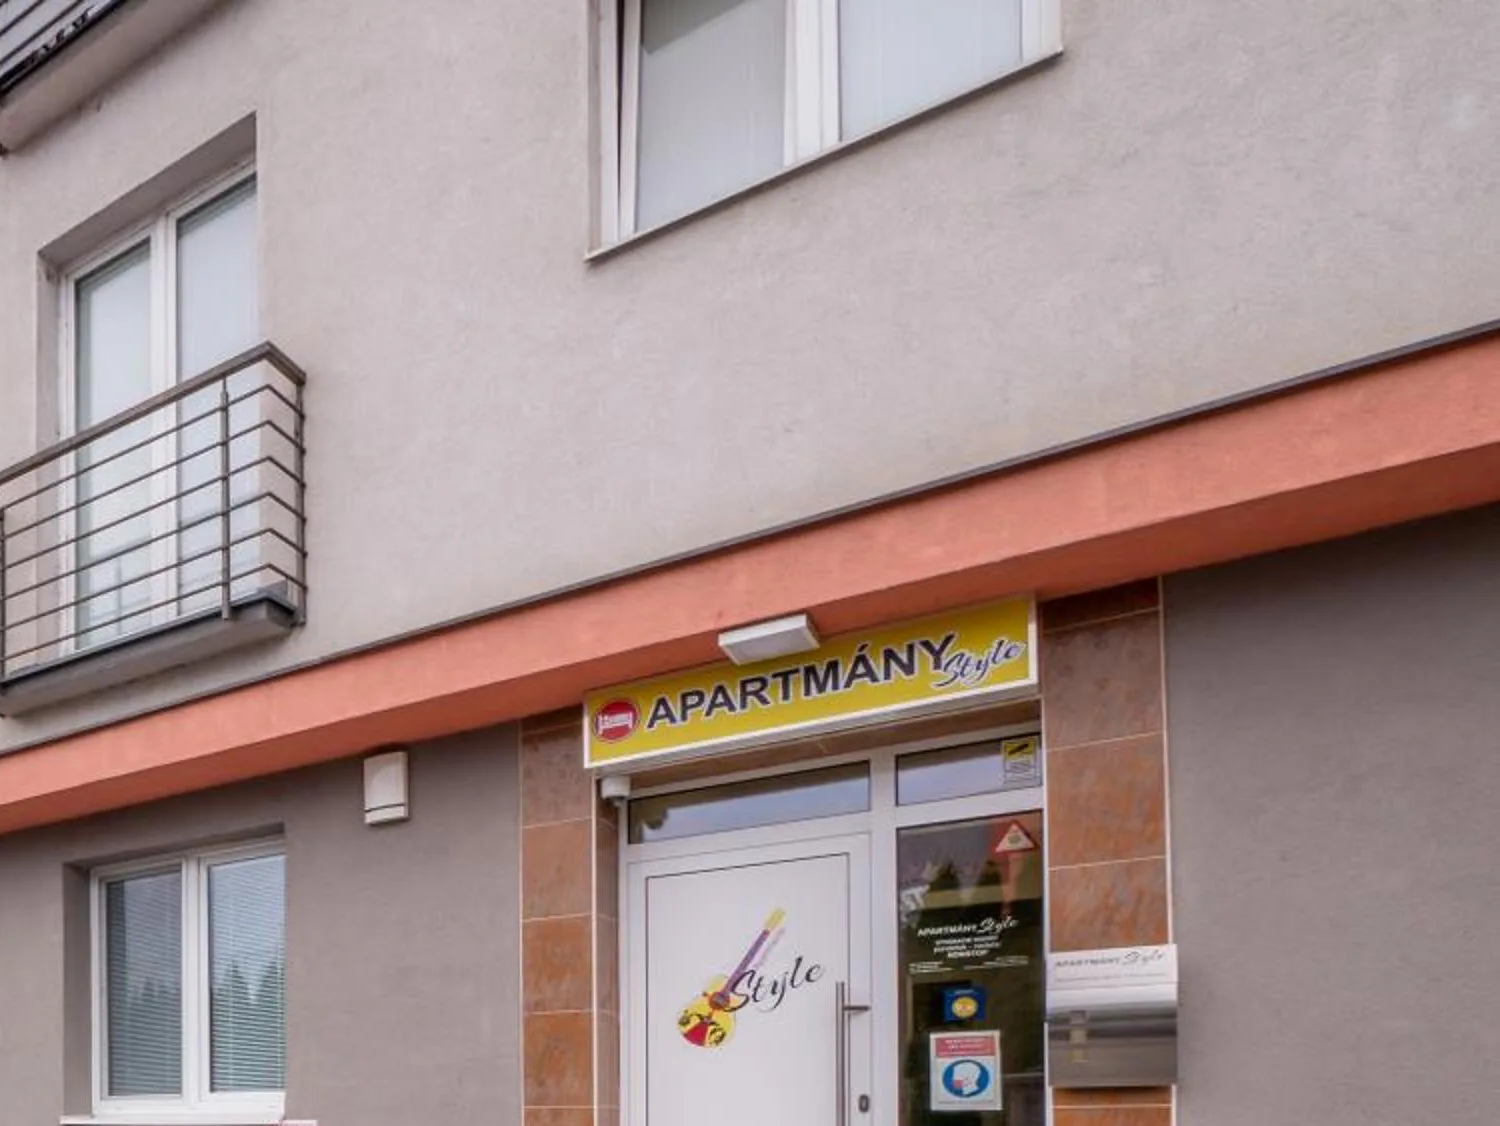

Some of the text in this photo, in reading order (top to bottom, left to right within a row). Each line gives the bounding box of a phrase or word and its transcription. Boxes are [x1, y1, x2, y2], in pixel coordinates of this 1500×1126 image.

[645, 632, 1026, 730] APARTMÁNY Style
[723, 955, 822, 1013] Style
